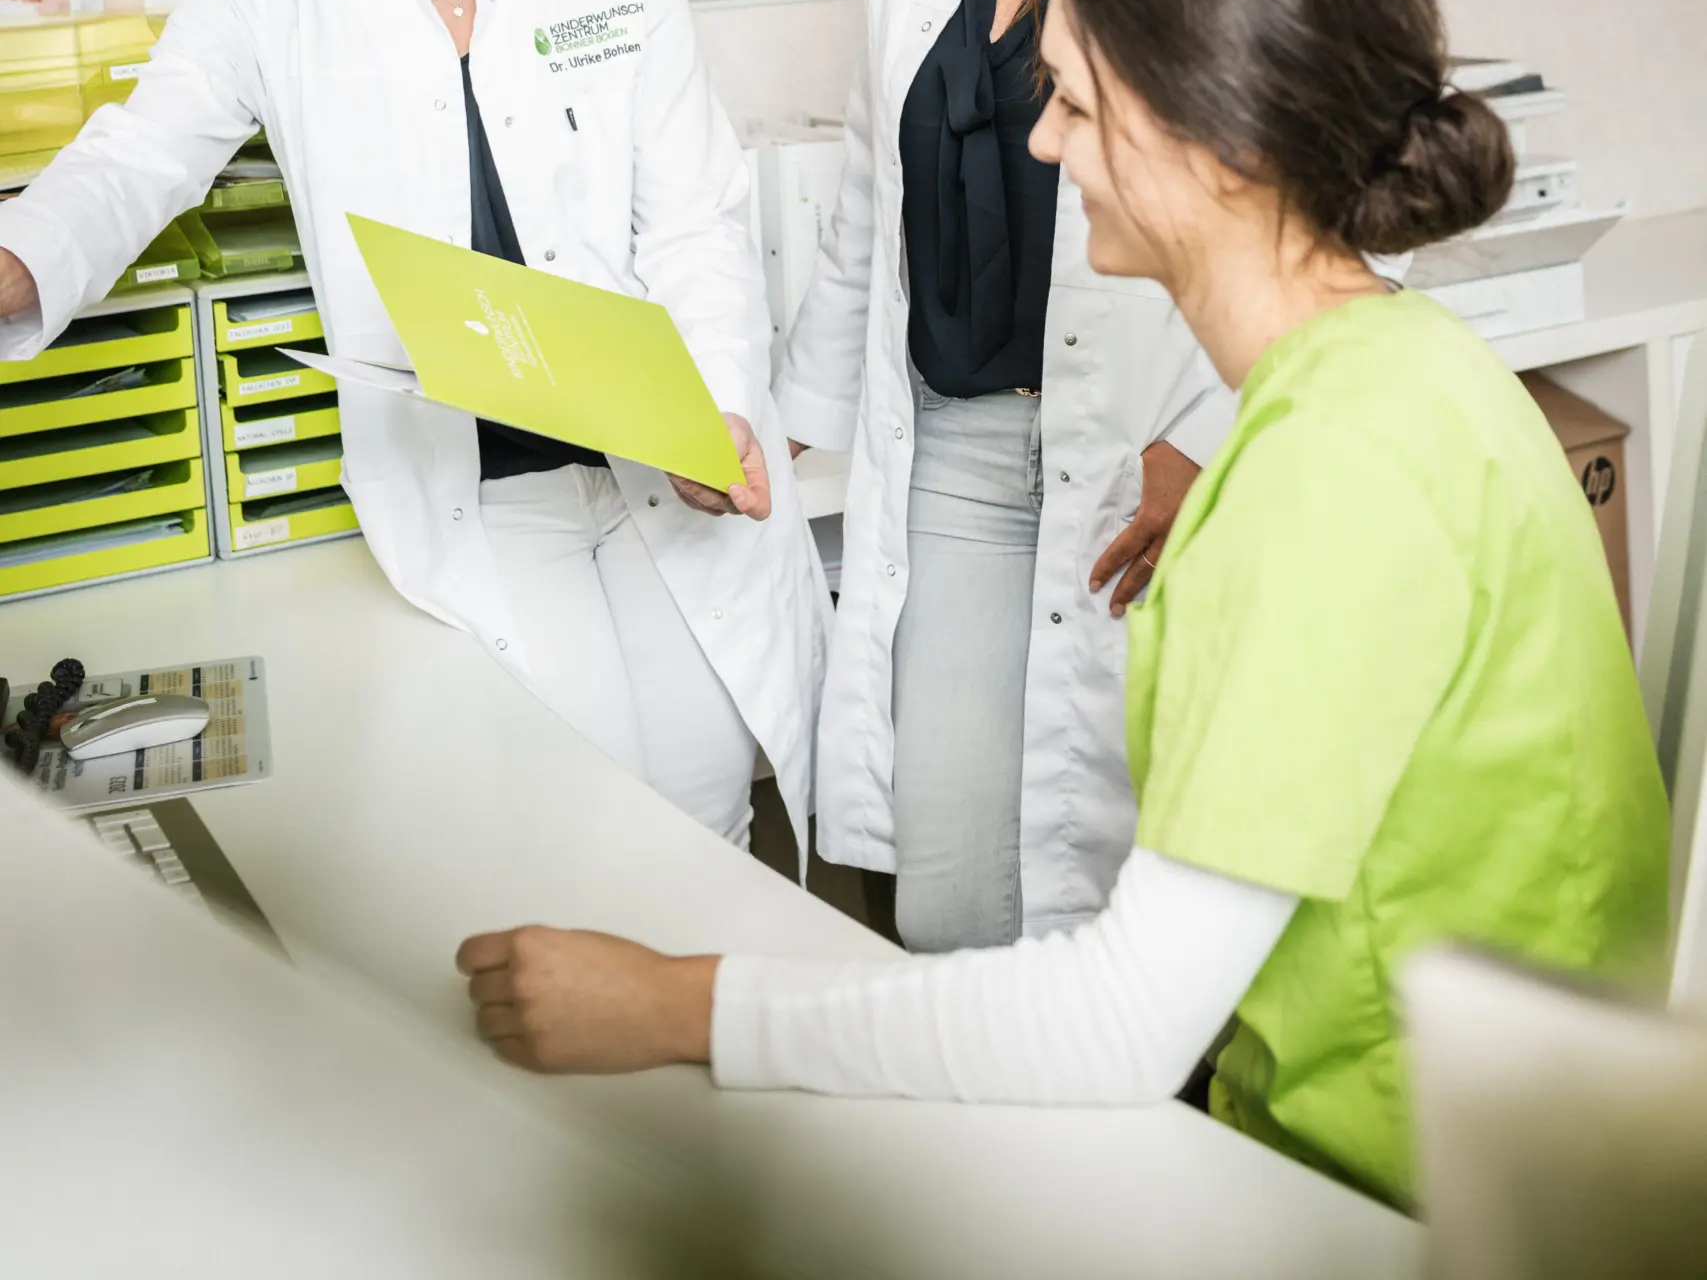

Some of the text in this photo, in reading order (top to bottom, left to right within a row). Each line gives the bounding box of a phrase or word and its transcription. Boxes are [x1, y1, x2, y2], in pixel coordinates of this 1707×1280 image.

[550, 2, 644, 35] KINDERWUNSCH
[552, 21, 609, 45] ZENTRUM
[555, 26, 628, 54] BONNER BOGEN
[549, 43, 641, 73] Dr. Ulrike Bohlen
[1586, 460, 1612, 505] hp
[108, 776, 127, 795] 2023
